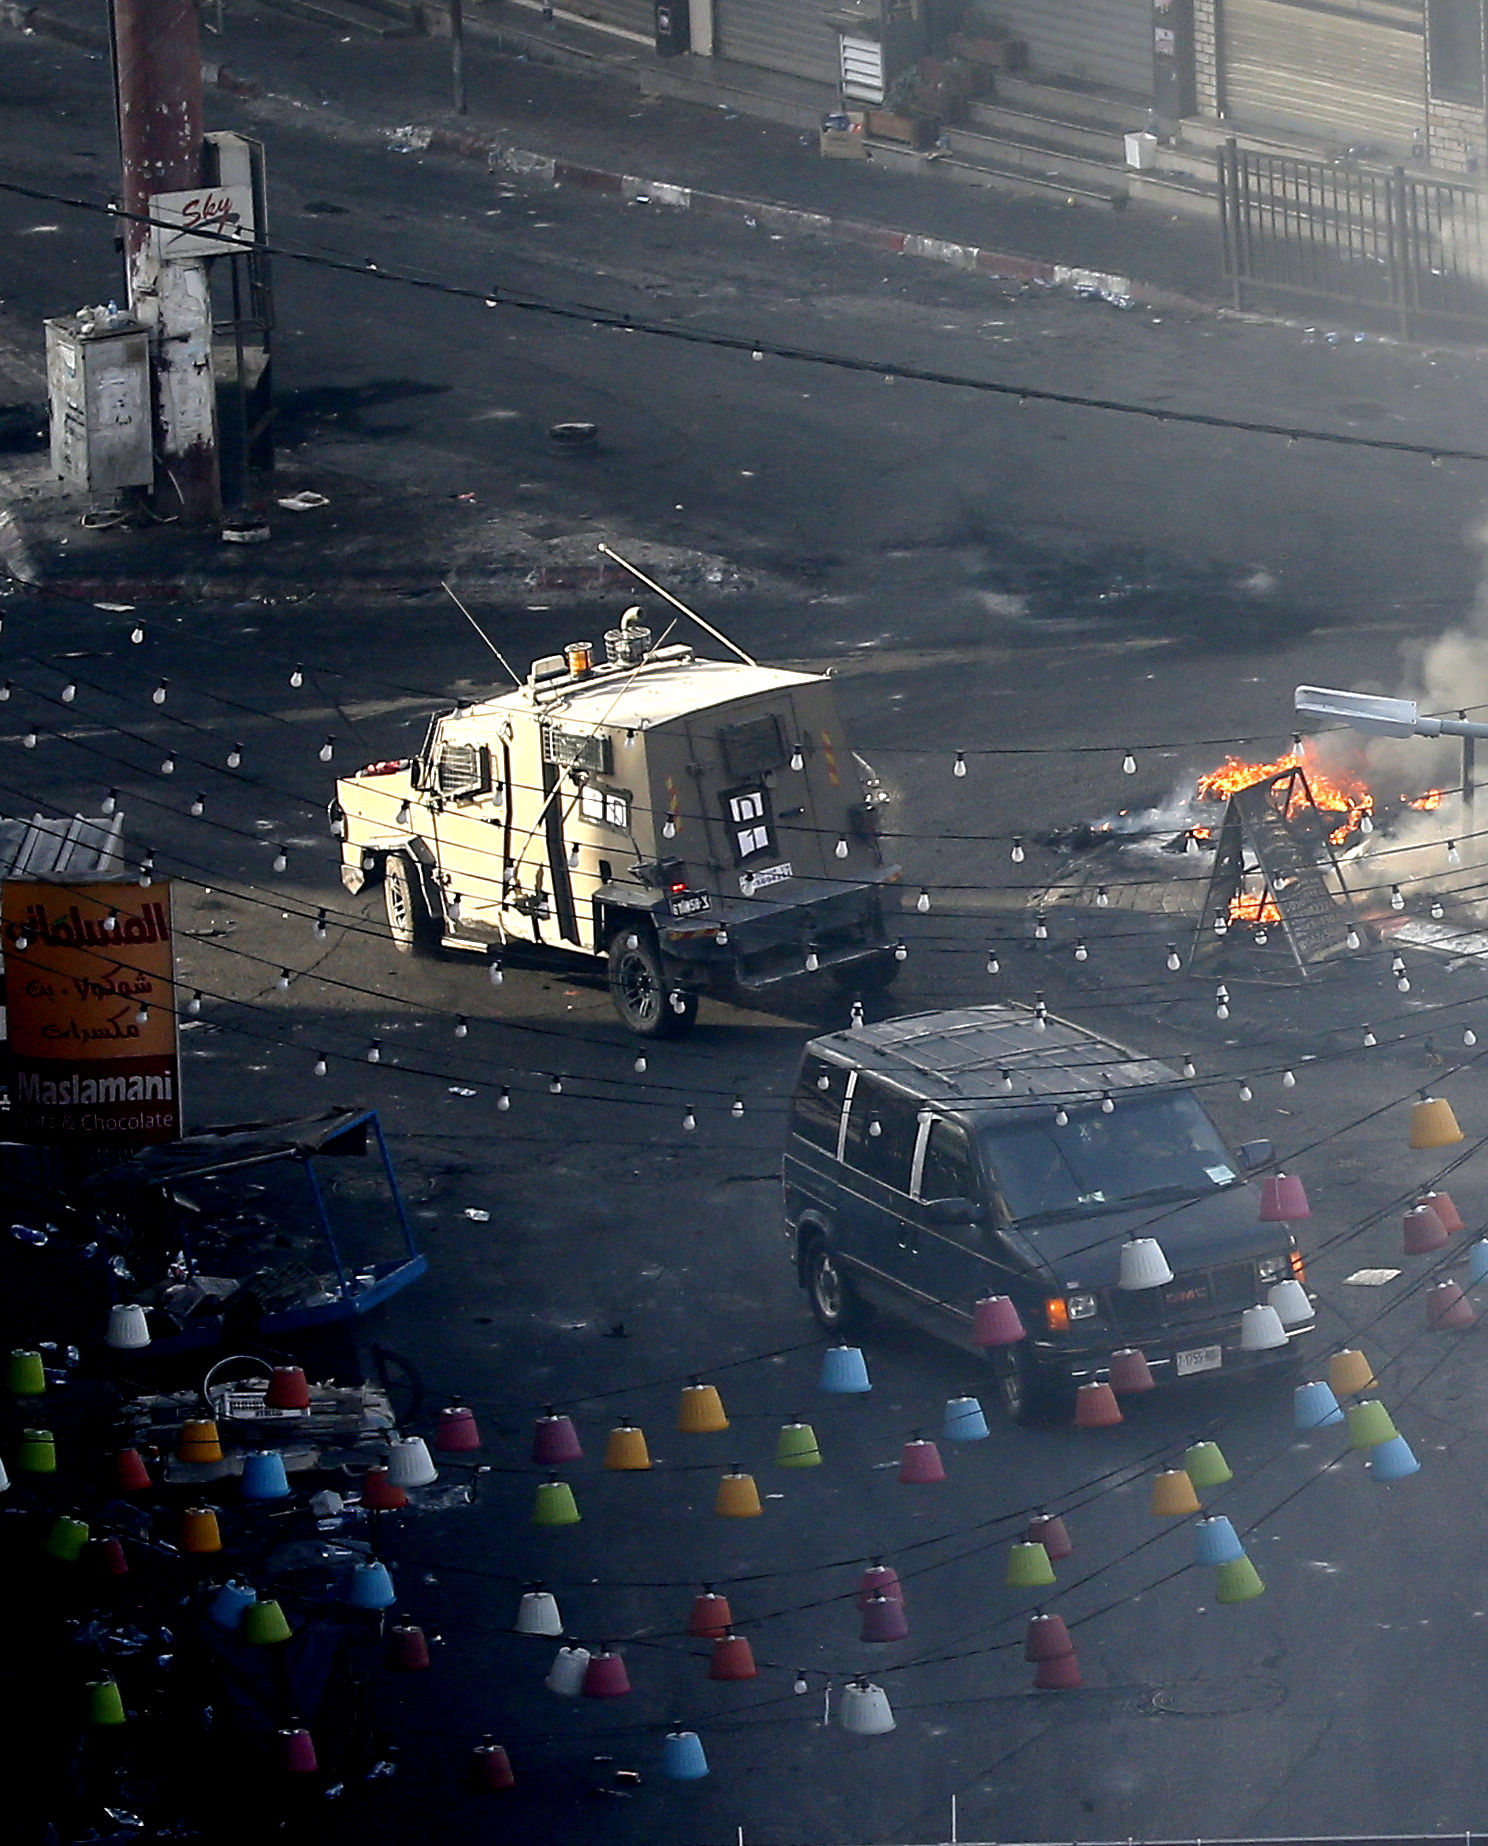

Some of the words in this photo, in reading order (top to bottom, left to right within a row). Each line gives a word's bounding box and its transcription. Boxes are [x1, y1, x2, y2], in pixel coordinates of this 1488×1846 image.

[182, 193, 233, 234] Sky
[18, 1070, 172, 1105] Maslamani
[81, 1111, 173, 1131] Chocolate
